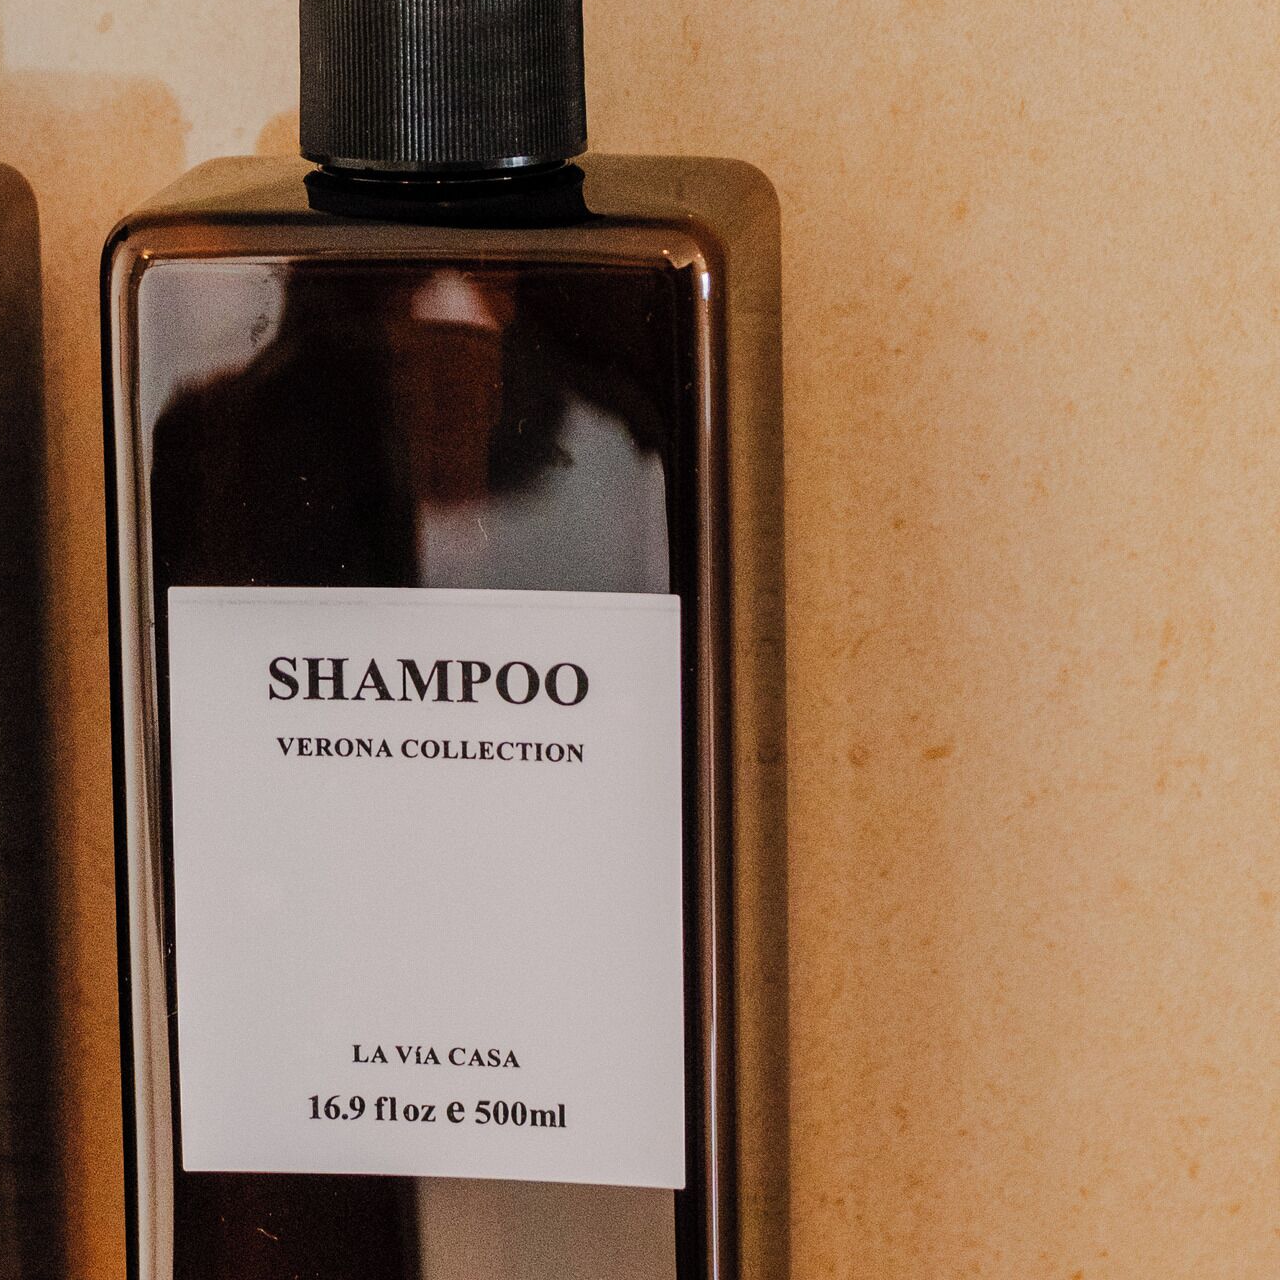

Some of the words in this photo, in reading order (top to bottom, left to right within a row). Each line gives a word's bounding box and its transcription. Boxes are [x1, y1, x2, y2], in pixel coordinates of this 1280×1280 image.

[268, 656, 590, 707] SHAMPOO
[276, 737, 393, 758] VERONA
[400, 738, 584, 763] COLLECTION
[352, 1044, 389, 1064] LA
[447, 1047, 521, 1069] CASA
[308, 1094, 366, 1121] 16.9
[446, 1101, 466, 1124] e
[474, 1100, 567, 1128] 500ml
